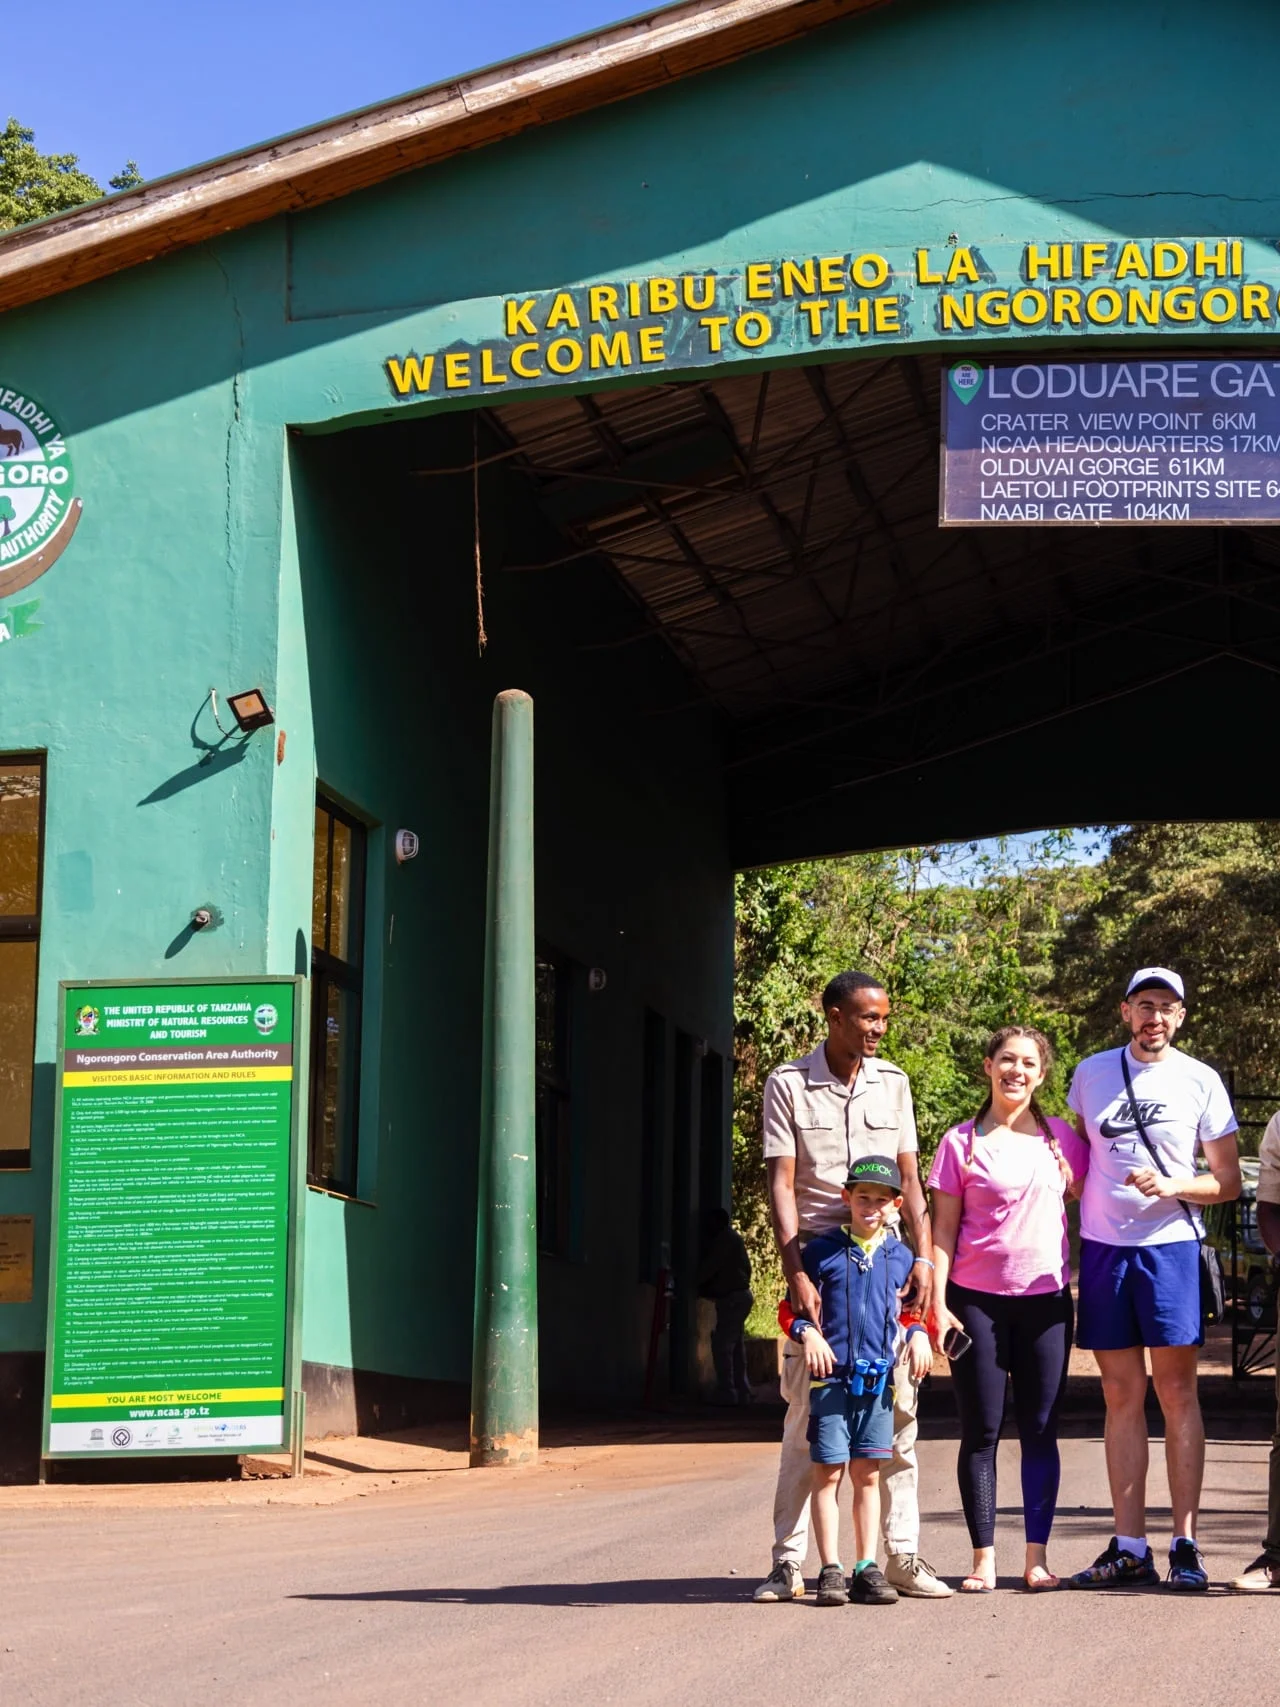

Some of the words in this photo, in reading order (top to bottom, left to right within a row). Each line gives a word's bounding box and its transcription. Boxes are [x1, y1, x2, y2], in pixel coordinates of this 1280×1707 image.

[506, 275, 717, 336] KARIBU
[747, 253, 889, 299] ENEO
[917, 248, 980, 283] LA
[1028, 242, 1243, 280] HIFADHI
[387, 325, 665, 393] WELCOME
[700, 311, 771, 352] TO
[800, 297, 900, 336] THE
[989, 364, 1199, 399] LODUARE
[981, 413, 1069, 431] CRATER
[1078, 413, 1134, 431] VIEW
[1139, 412, 1203, 430] POINT
[1212, 412, 1256, 430] 6KM
[44, 433, 66, 461] YA
[981, 436, 1041, 453] NCAA
[1046, 435, 1224, 453] HEADQUARTERS
[980, 458, 1074, 476] OLDUVAI
[1079, 458, 1159, 476] GORGE
[1168, 457, 1225, 475] 61KM
[981, 481, 1067, 498] LAETOLI
[1073, 480, 1210, 498] FOOTPRINTS
[1215, 480, 1262, 498] SITE
[981, 504, 1044, 520] NAABI
[1054, 503, 1112, 520] GATE
[1124, 503, 1190, 520] 104KM
[0, 488, 64, 561] AUTHORITY
[104, 1006, 121, 1015] THE
[123, 1005, 152, 1014] UNITED
[155, 1004, 194, 1014] REPUBLIC
[197, 1004, 208, 1013] OF
[210, 1003, 252, 1012] TANZANIA
[106, 1018, 145, 1028] MINISTRY
[148, 1018, 159, 1027] OF
[162, 1017, 199, 1026] NATURAL
[202, 1015, 248, 1025] RESOURCES
[150, 1030, 168, 1039] AND
[170, 1029, 207, 1039] TOURISM
[76, 1053, 137, 1065] Ngorongoro
[138, 1051, 204, 1062] Conservation
[206, 1050, 229, 1060] Area
[230, 1049, 279, 1061] Authority
[92, 1074, 128, 1083] VISITORS
[129, 1073, 152, 1082] BASIC
[154, 1072, 209, 1082] INFORMATION
[212, 1071, 230, 1079] AND
[231, 1070, 257, 1079] RULES
[865, 1163, 892, 1177] XBOX
[107, 1396, 127, 1404] YOU
[129, 1395, 146, 1403] ARE
[148, 1394, 174, 1402] MOST
[177, 1392, 222, 1401] WELCOME
[129, 1406, 210, 1419] www.ncaa.go.tz
